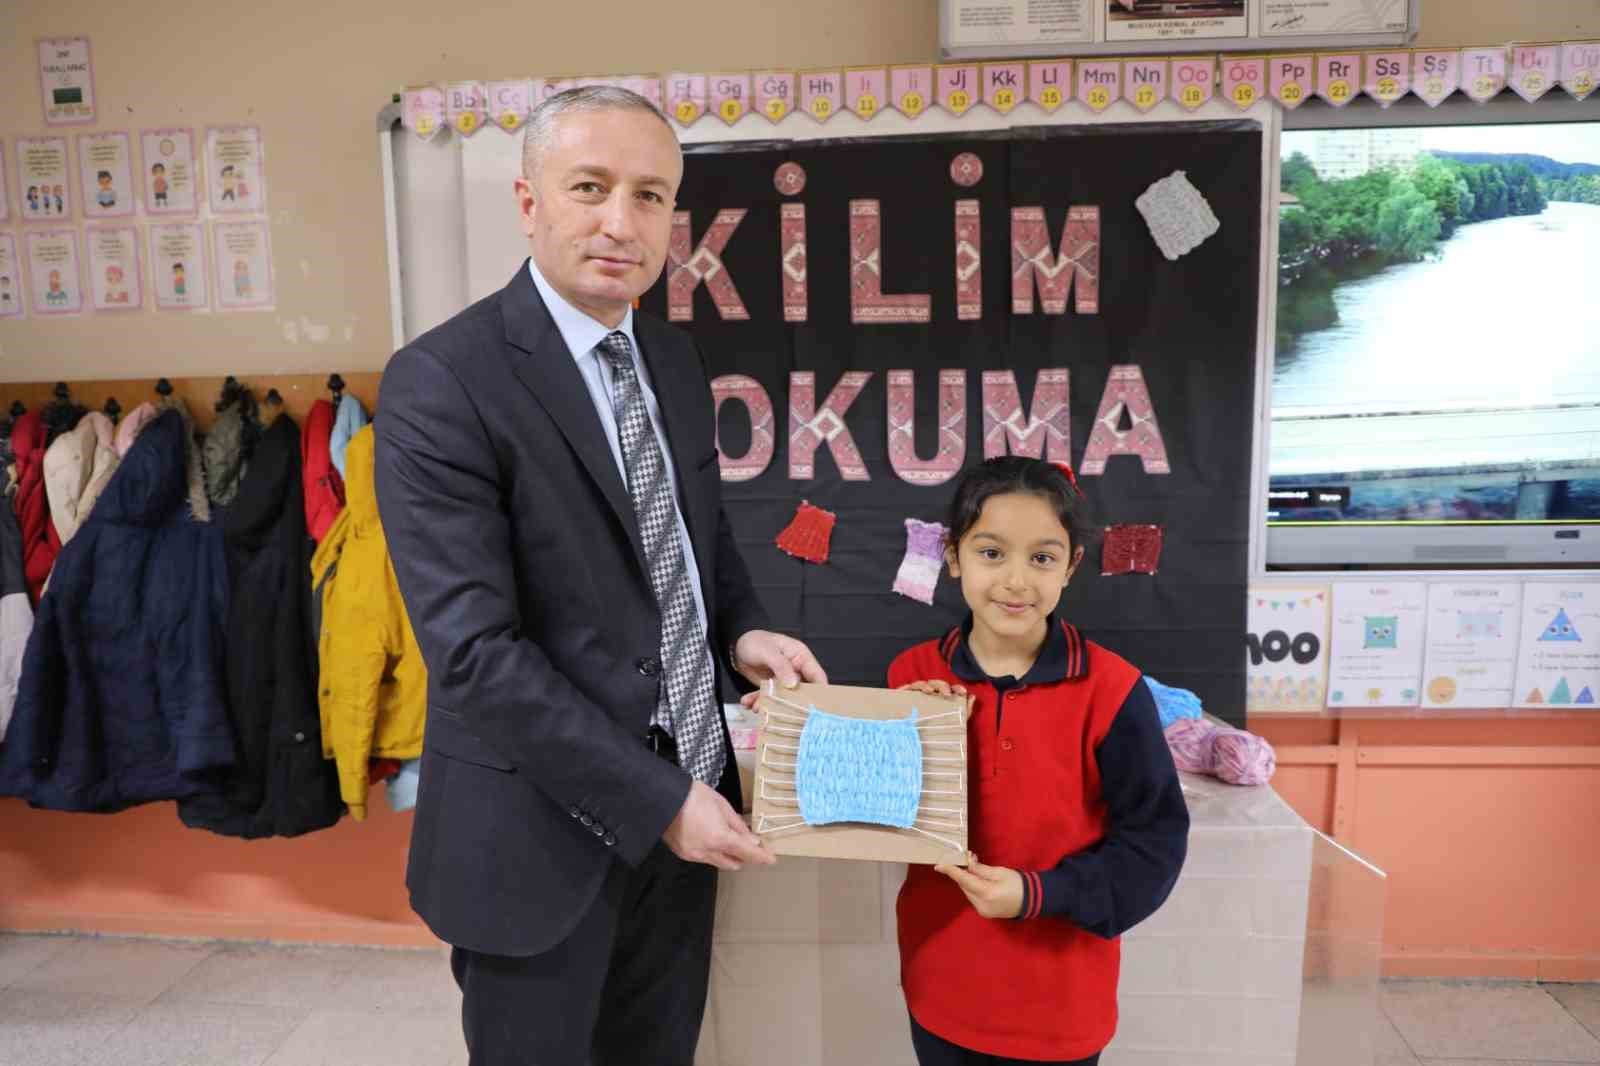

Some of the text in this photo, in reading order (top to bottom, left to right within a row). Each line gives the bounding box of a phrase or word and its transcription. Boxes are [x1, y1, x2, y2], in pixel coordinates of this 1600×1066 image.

[1132, 66, 1161, 84] Nn
[1282, 62, 1305, 80] Pp
[1329, 60, 1351, 77] Rr
[1374, 57, 1402, 77] Ss
[949, 68, 967, 90] Jj
[991, 69, 1017, 86] Kk
[1042, 67, 1058, 84] Ll
[1083, 68, 1117, 84] Mm
[717, 79, 743, 100] Gg
[809, 78, 834, 95] Hh
[1236, 88, 1251, 101] 19
[1284, 87, 1299, 99] 20
[1331, 86, 1347, 97] 21
[452, 90, 477, 109] Bb
[951, 95, 966, 108] 13
[995, 93, 1012, 106] 14
[1043, 91, 1058, 104] 15
[1091, 90, 1106, 104] 16
[1137, 90, 1153, 104] 17
[1185, 89, 1200, 102] 18
[815, 102, 829, 114] 10
[860, 99, 874, 112] 11
[666, 151, 1101, 324] KİLİM
[710, 363, 1172, 486] OKUMA
